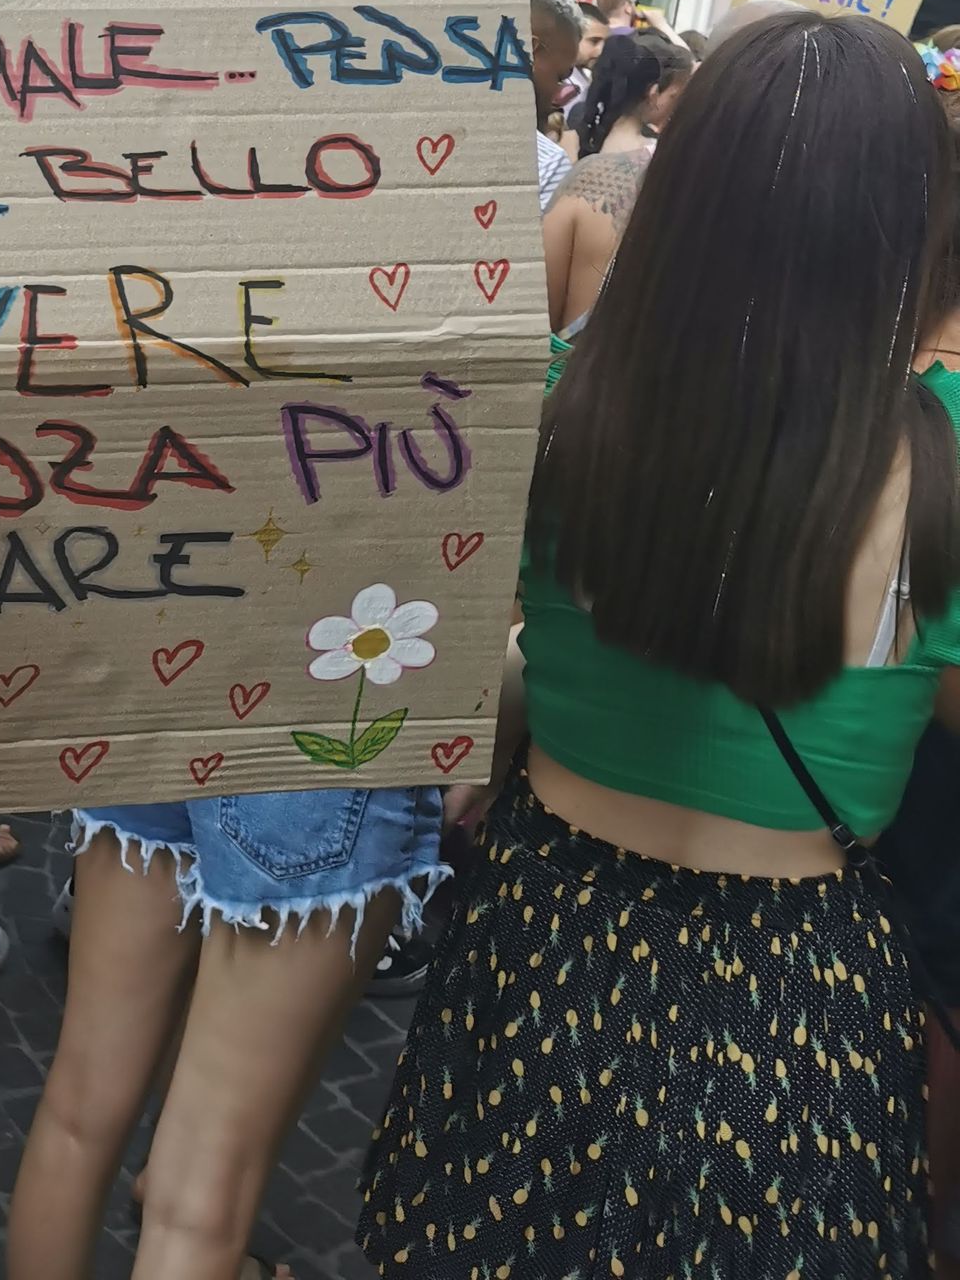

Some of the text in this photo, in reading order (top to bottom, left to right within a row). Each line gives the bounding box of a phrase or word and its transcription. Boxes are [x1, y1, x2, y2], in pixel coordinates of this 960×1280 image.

[254, 4, 534, 92] PENSA
[18, 133, 382, 202] BELLO
[280, 370, 472, 506] PIÙ
